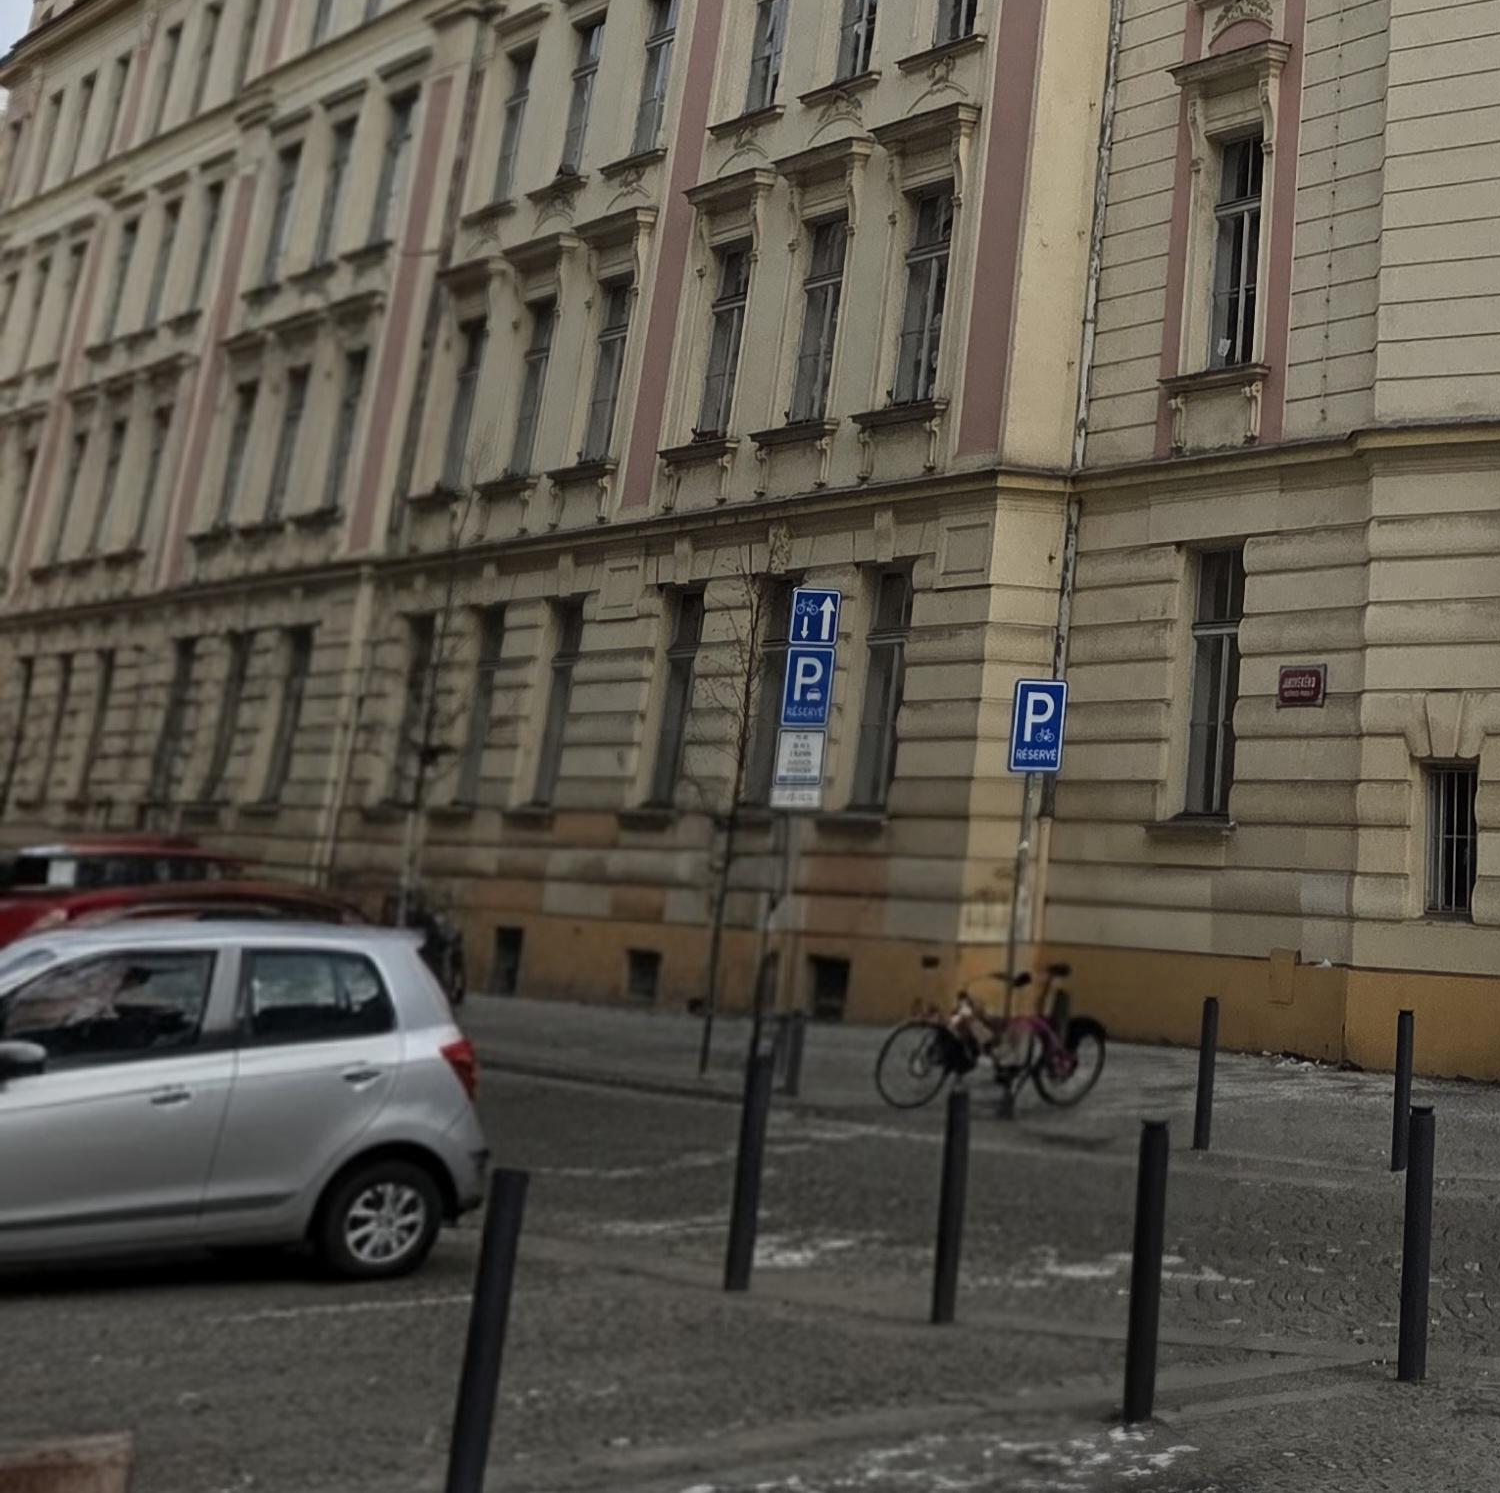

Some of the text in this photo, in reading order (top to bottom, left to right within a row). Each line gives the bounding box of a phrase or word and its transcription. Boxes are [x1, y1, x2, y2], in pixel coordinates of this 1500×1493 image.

[793, 656, 824, 702] P
[1023, 691, 1055, 743] P
[1015, 747, 1057, 761] RÉSERVÉ
